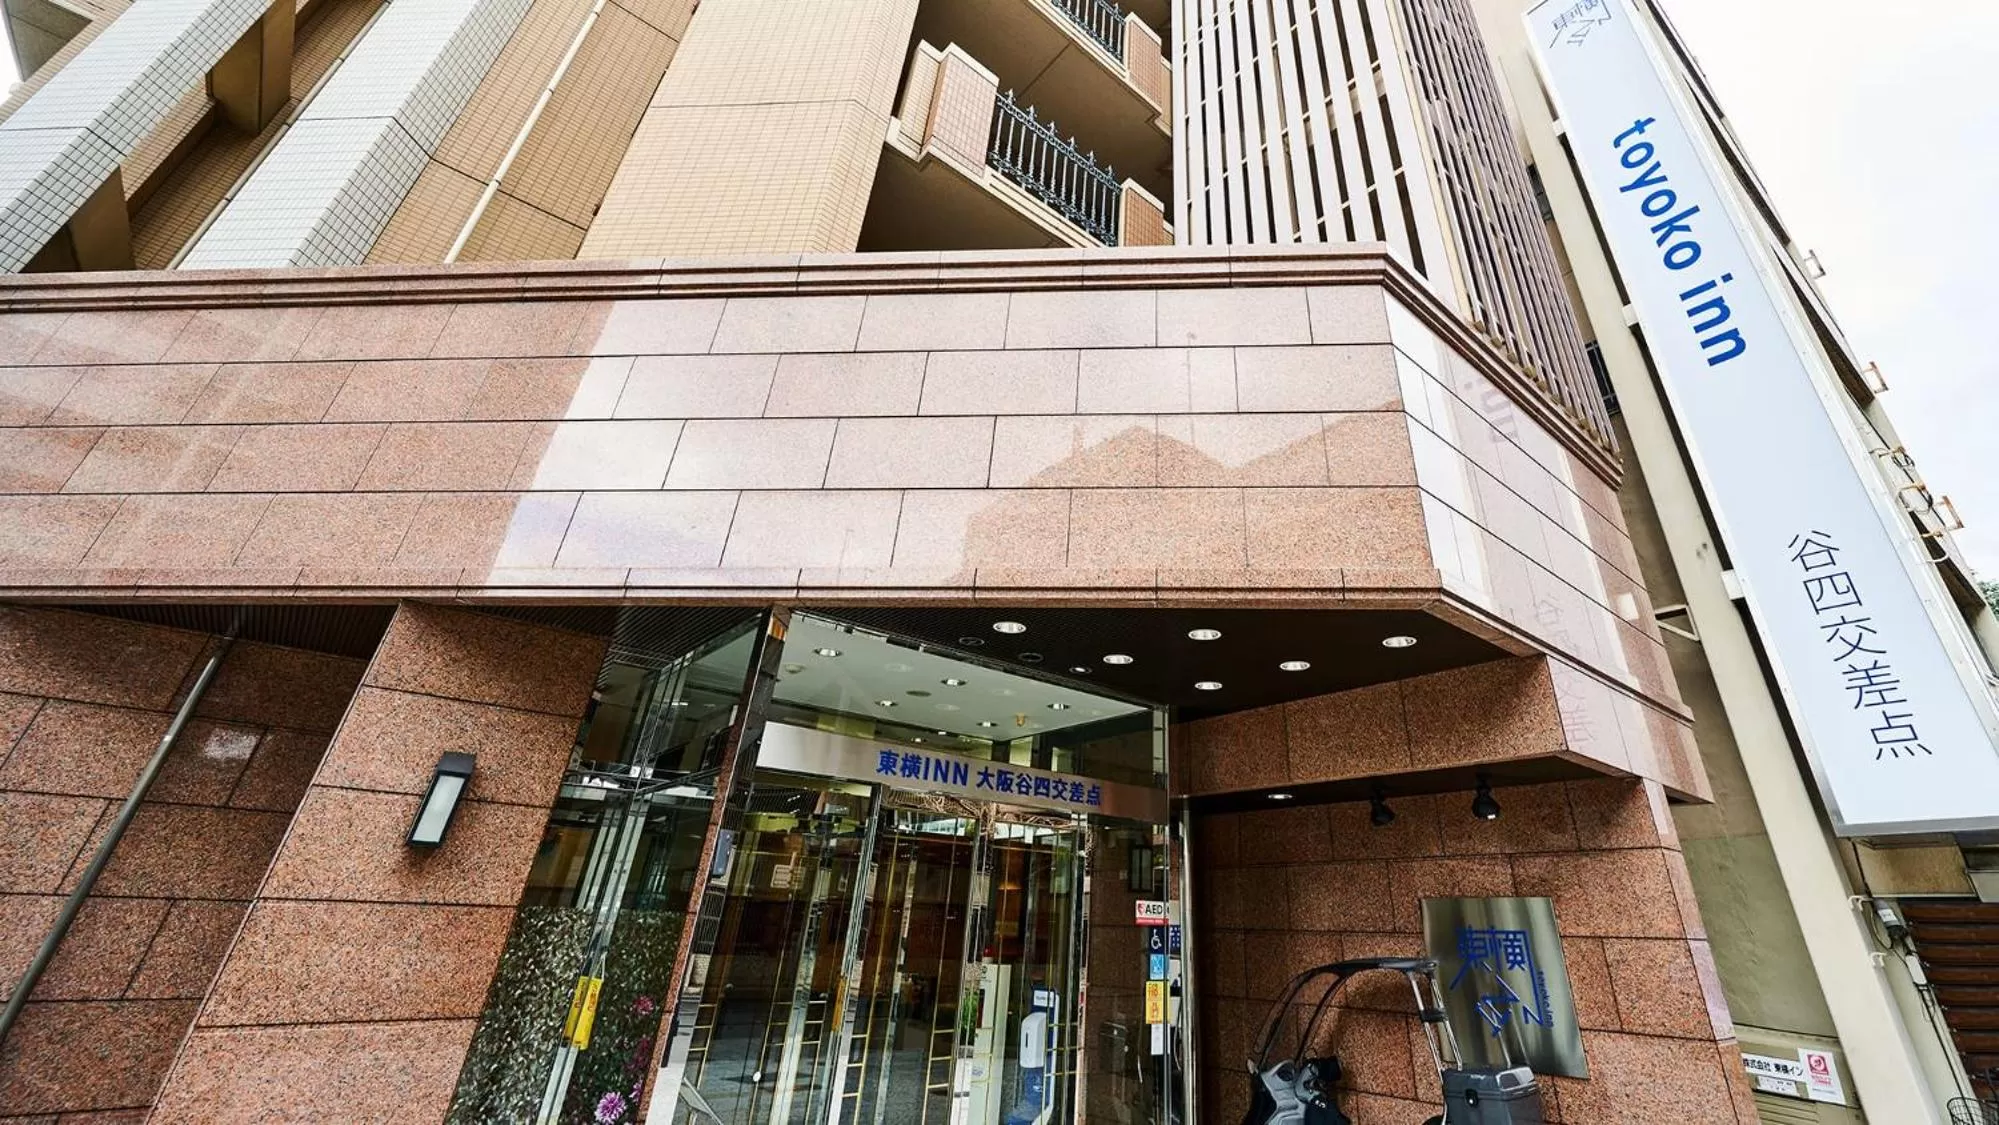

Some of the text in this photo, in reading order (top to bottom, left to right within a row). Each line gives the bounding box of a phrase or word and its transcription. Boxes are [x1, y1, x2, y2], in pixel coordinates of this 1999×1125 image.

[1613, 117, 1747, 367] toyoko inn
[1788, 530, 1932, 760] 谷四交差点
[876, 749, 1102, 806] 東横INN 大阪谷四交差点
[1145, 904, 1163, 915] AED
